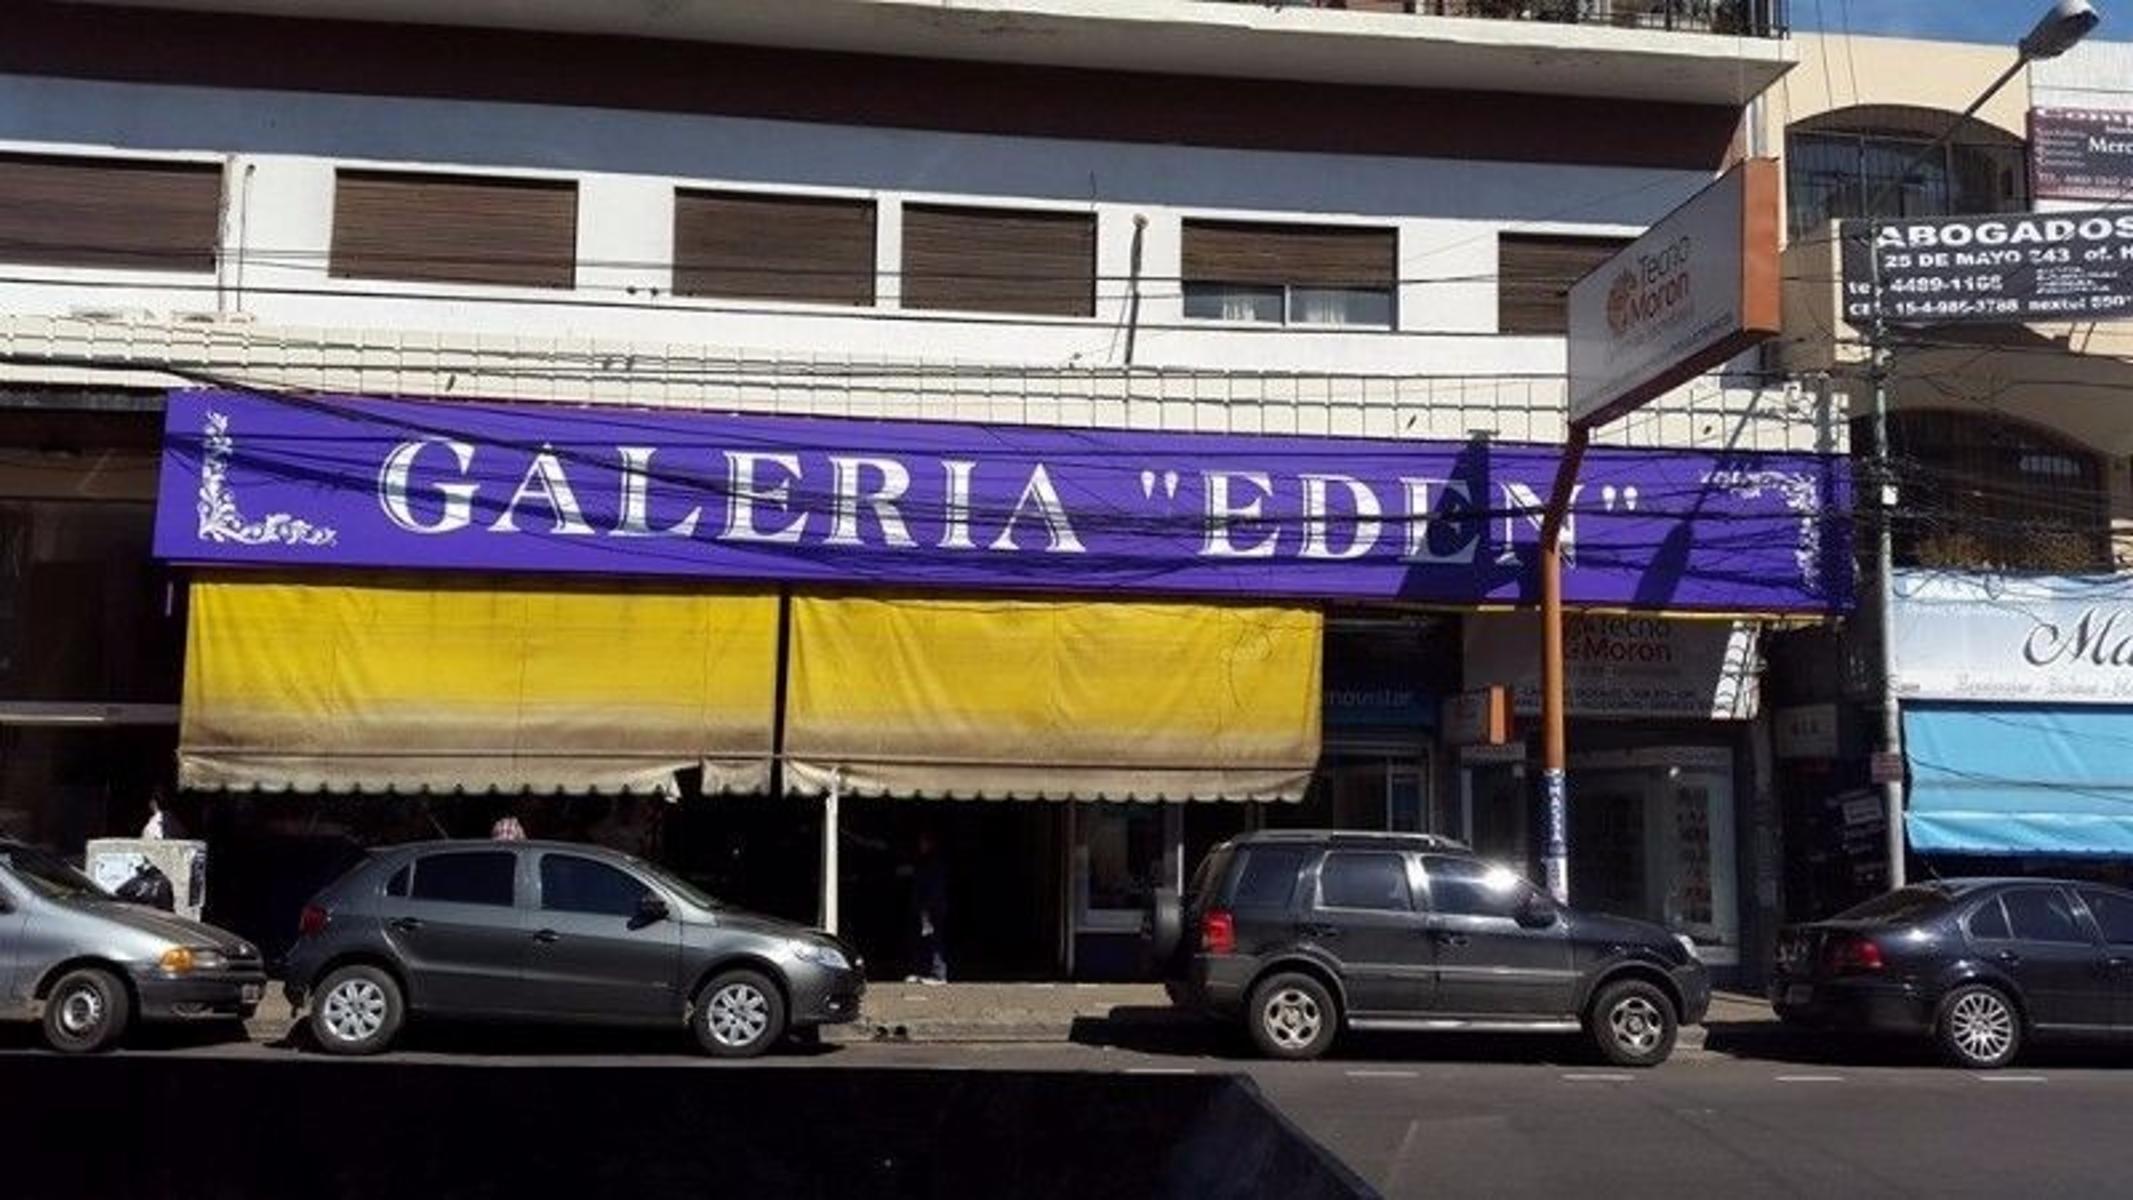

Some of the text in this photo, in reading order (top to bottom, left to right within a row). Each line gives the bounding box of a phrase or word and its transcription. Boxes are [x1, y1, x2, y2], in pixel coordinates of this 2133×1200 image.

[1877, 215, 2133, 247] ABOGADOS
[1885, 254, 1912, 268] 25
[1919, 253, 1949, 267] DE
[1955, 249, 2022, 265] MAYO
[378, 439, 1086, 552] GALERIA
